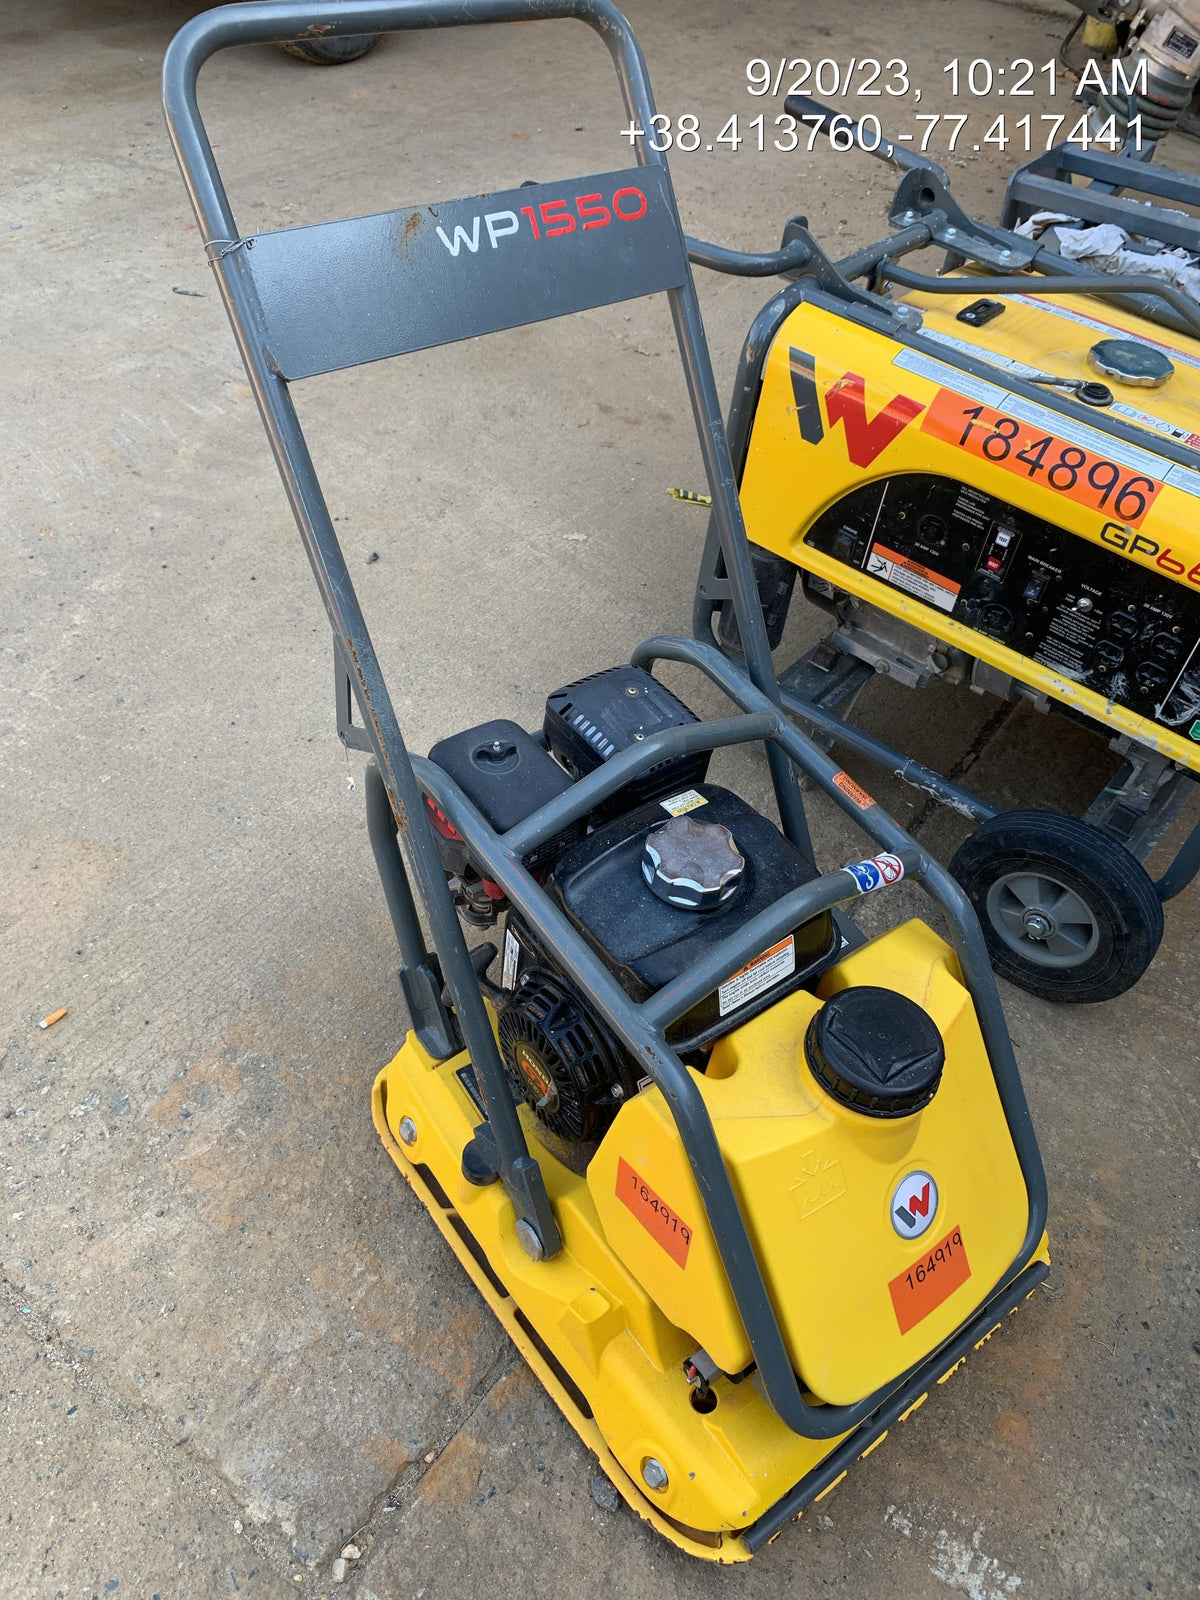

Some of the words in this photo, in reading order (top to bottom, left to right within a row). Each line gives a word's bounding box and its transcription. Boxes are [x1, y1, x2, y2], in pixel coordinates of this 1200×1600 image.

[435, 187, 647, 257] WP1550
[959, 405, 1155, 521] 184896
[998, 536, 1008, 544] TEST
[1081, 583, 1103, 597] VOLTAGE
[522, 1049, 551, 1086] HOND
[630, 1176, 691, 1244] 164919
[904, 1231, 964, 1291] 164919
